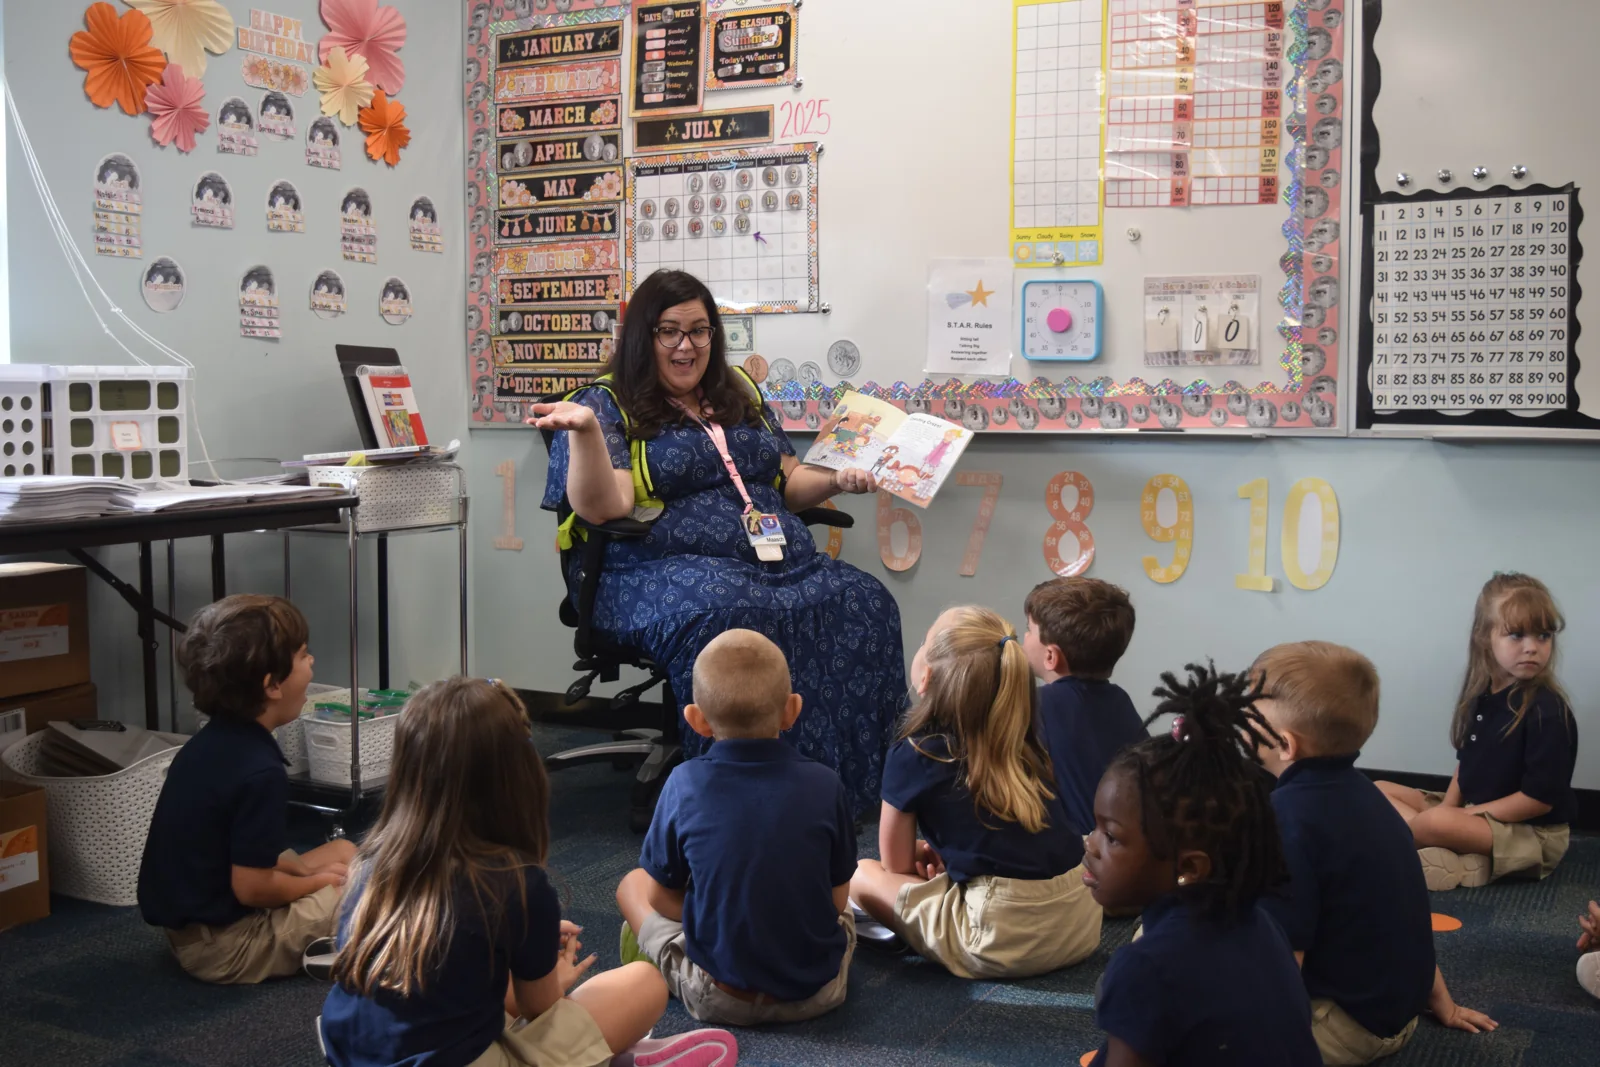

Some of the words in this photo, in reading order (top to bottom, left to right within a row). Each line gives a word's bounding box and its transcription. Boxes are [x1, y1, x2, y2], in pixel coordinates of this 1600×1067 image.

[644, 13, 662, 22] DAYS
[674, 8, 695, 18] WEEK
[1268, 4, 1280, 12] 120
[251, 9, 302, 40] HAPPY
[722, 21, 738, 30] THE
[740, 17, 772, 28] SEASON
[775, 16, 784, 25] IS
[239, 28, 313, 64] BIRTHDAY
[521, 32, 595, 57] JANUARY
[724, 32, 775, 47] Summer
[1268, 33, 1280, 41] 130
[719, 55, 744, 65] Today's
[745, 52, 777, 62] Weather
[1266, 62, 1278, 70] 140
[514, 69, 601, 96] FEBRUARY
[1266, 91, 1278, 99] 150
[529, 105, 586, 127] MARCH
[1178, 103, 1187, 111] 60
[780, 99, 831, 139] 2025
[681, 118, 723, 140] JULY
[534, 141, 582, 162] APRIL
[1263, 149, 1275, 157] 170
[692, 178, 698, 188] 1
[714, 177, 721, 188] 2
[741, 174, 749, 184] 3
[767, 172, 774, 182] 4
[791, 169, 797, 180] 5
[1263, 178, 1275, 186] 180
[543, 178, 577, 198] MAY
[645, 203, 652, 214] 6
[693, 200, 699, 210] 8
[715, 198, 721, 208] 9
[739, 199, 750, 209] 10
[766, 196, 774, 206] 11
[788, 194, 800, 205] 12
[1381, 210, 1385, 220] 1
[1398, 209, 1405, 219] 2
[1417, 207, 1424, 218] 3
[1436, 207, 1443, 217] 4
[1455, 205, 1463, 216] 5
[1474, 204, 1482, 215] 6
[1494, 203, 1502, 214] 7
[1514, 202, 1522, 214] 8
[1533, 201, 1542, 212] 9
[1553, 200, 1565, 212] 10
[536, 215, 576, 234] JUNE
[640, 225, 650, 236] 13
[665, 224, 676, 234] 14
[691, 222, 700, 232] 15
[713, 221, 723, 231] 16
[738, 219, 746, 228] 17
[1379, 231, 1387, 241] 11
[1397, 229, 1406, 240] 12
[1416, 228, 1426, 239] 13
[1434, 228, 1445, 238] 14
[1453, 226, 1464, 237] 15
[1472, 225, 1484, 236] 16
[1492, 224, 1504, 235] 17
[1512, 223, 1523, 235] 18
[1532, 222, 1544, 234] 19
[1550, 221, 1567, 233] 20
[526, 249, 584, 272] AUGUST
[1378, 251, 1388, 262] 21
[1395, 250, 1408, 261] 22
[1414, 249, 1428, 260] 23
[1432, 248, 1447, 259] 24
[1452, 247, 1466, 258] 25
[1470, 247, 1485, 258] 26
[1490, 246, 1505, 257] 27
[1510, 245, 1525, 256] 28
[1529, 244, 1545, 255] 29
[1550, 243, 1567, 255] 30
[1378, 272, 1388, 282] 31
[1395, 271, 1408, 282] 32
[1413, 270, 1427, 281] 33
[1432, 269, 1447, 280] 34
[1451, 268, 1466, 280] 35
[1470, 268, 1486, 279] 36
[1490, 267, 1505, 278] 37
[1510, 266, 1525, 278] 38
[1529, 265, 1545, 277] 39
[1550, 264, 1567, 276] 40
[513, 279, 606, 299] SEPTEMBER
[523, 313, 592, 332] OCTOBER
[1225, 320, 1240, 342] 0
[513, 342, 598, 360] NOVEMBER
[1064, 473, 1074, 482] 24
[1080, 481, 1089, 490] 32
[1050, 484, 1059, 493] 16
[1053, 501, 1059, 510] 8
[1080, 498, 1090, 506] 40
[956, 471, 1002, 576] 7
[1043, 470, 1095, 577] 8
[1056, 521, 1066, 530] 56
[1070, 512, 1081, 521] 48
[1080, 531, 1089, 540] 96
[1140, 473, 1194, 584] 9
[1235, 477, 1340, 592] 10
[1050, 559, 1060, 568] 72
